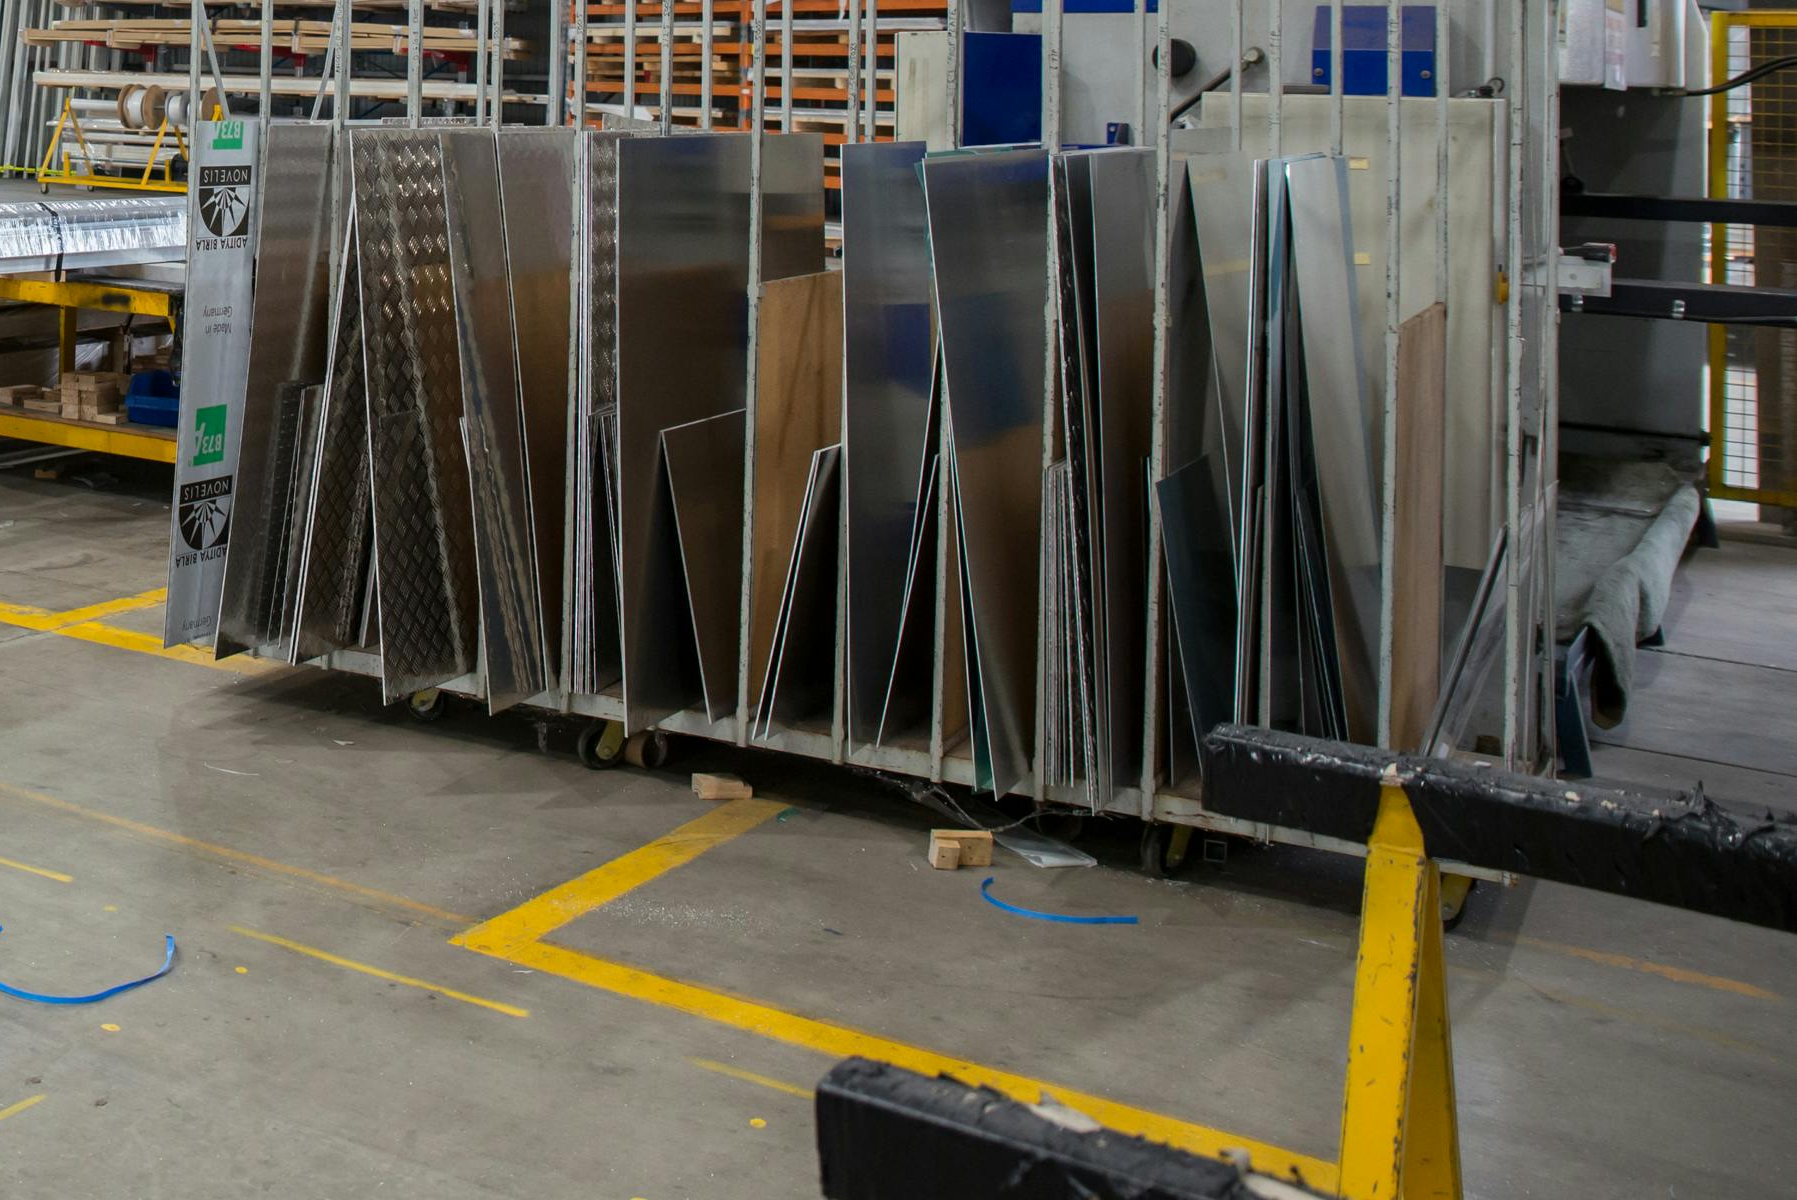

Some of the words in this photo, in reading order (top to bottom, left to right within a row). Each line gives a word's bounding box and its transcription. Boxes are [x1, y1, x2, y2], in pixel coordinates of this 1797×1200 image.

[203, 168, 248, 184] NOVELIS
[195, 239, 218, 251] BIRLA
[221, 237, 248, 250] ADITYA
[203, 305, 233, 319] Germany
[213, 322, 232, 335] Made
[184, 479, 229, 500] NOVELIS
[176, 553, 197, 569] BIRLA
